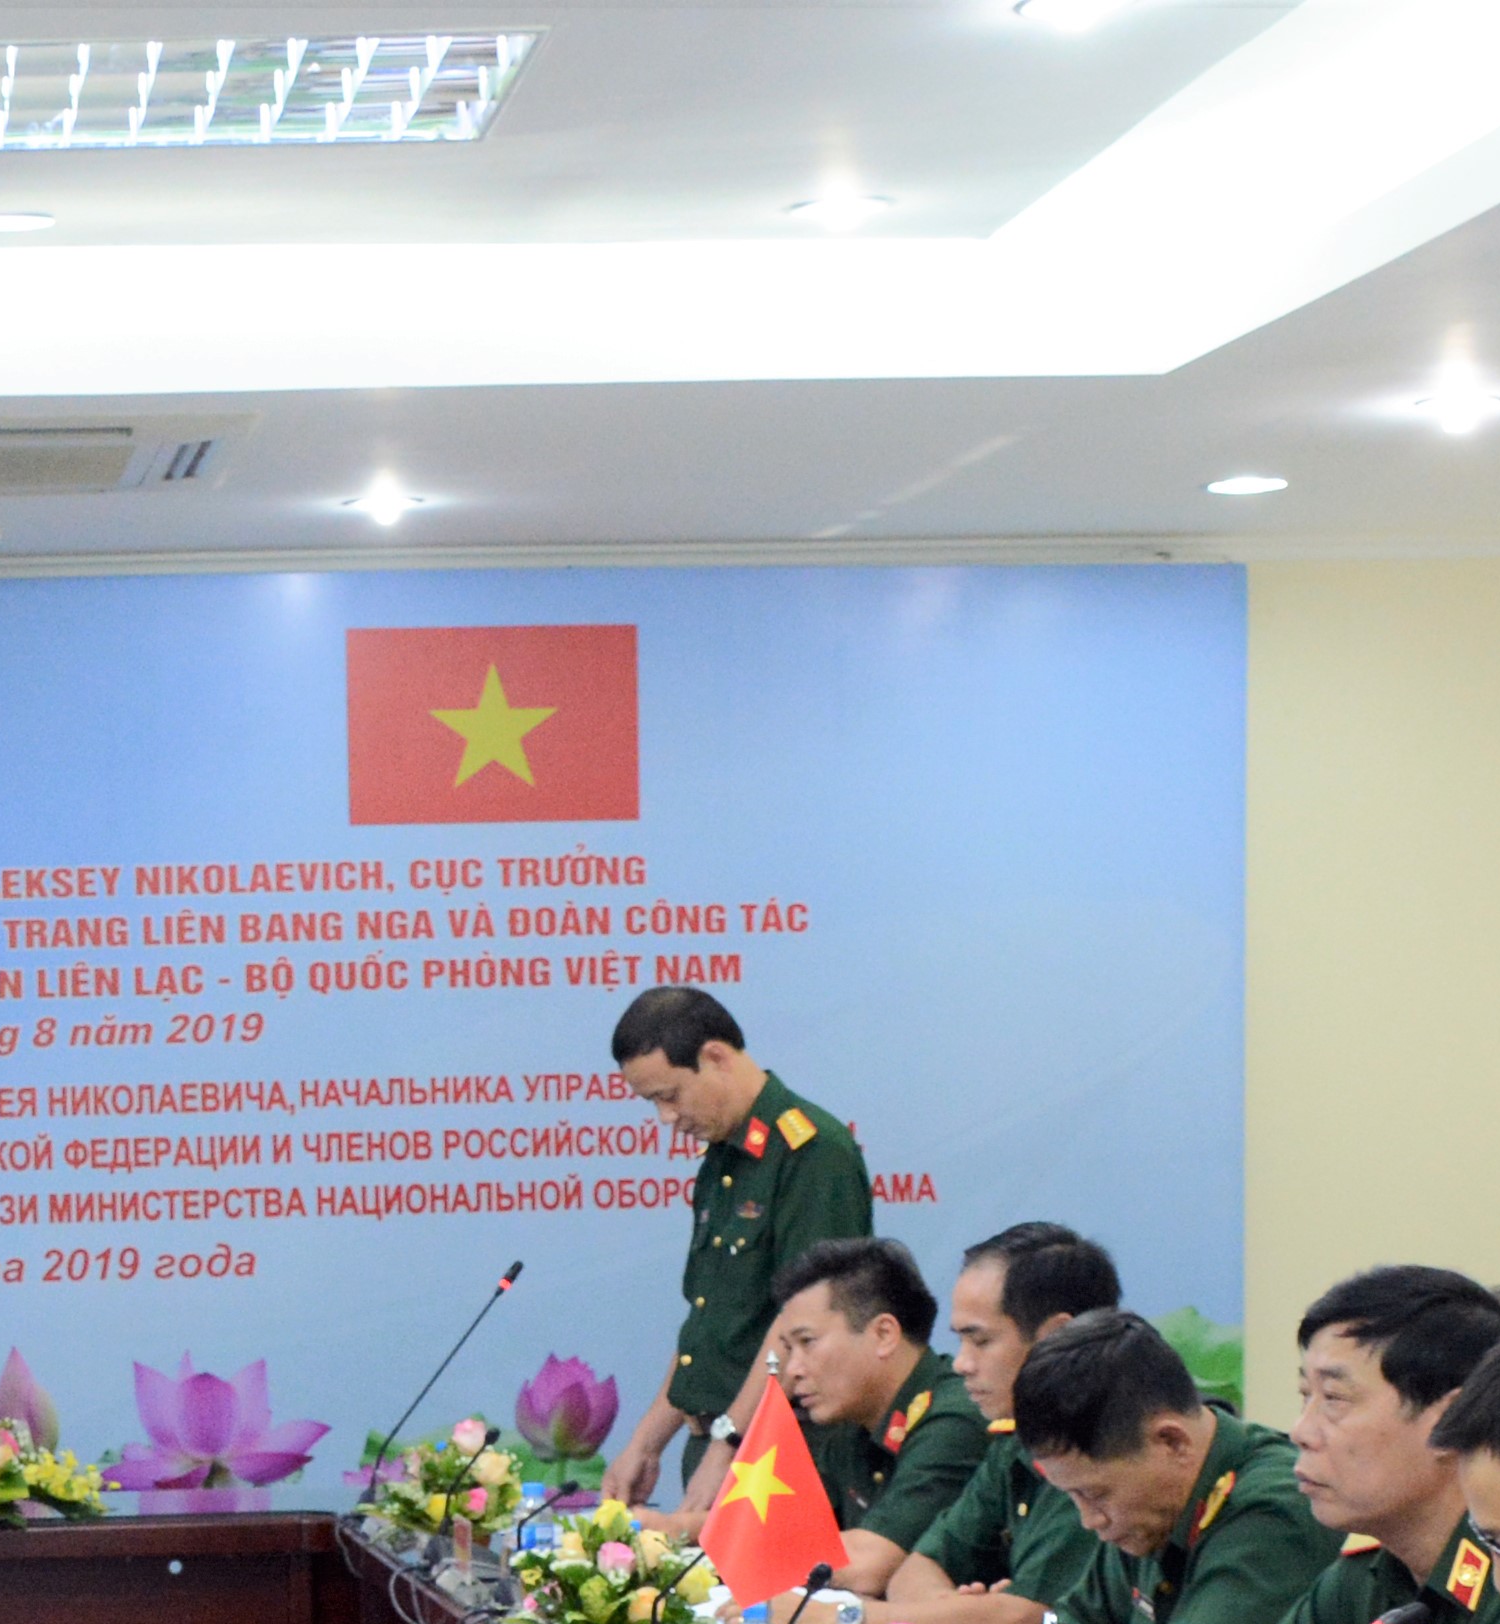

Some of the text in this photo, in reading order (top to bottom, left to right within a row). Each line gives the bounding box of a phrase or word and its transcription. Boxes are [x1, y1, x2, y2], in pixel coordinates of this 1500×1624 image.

[135, 861, 395, 896] NIKOLAEVICH,
[409, 858, 483, 895] CỤC
[497, 844, 646, 888] TRƯỞNG
[4, 917, 129, 949] TRANG
[143, 910, 226, 946] LIÊN
[239, 911, 343, 944] BANG
[357, 909, 435, 940] NGA
[448, 904, 495, 939] VÀ
[508, 902, 611, 938] ĐOÀN
[625, 899, 727, 935] CÔNG
[740, 898, 808, 933] TÁC
[37, 962, 120, 998] LIÊN
[134, 964, 204, 1002] LẠC
[245, 957, 295, 999] BỘ
[309, 952, 408, 995] QUỐC
[423, 952, 551, 989] PHÒNG
[564, 950, 642, 991] VIỆT
[655, 953, 742, 986] NAM
[33, 1017, 56, 1048] 8
[70, 1016, 153, 1046] năm
[167, 1012, 264, 1044] 2019
[523, 1073, 638, 1103] УПРАВ
[64, 1136, 262, 1173] ФЕДЕРАЦИИ
[272, 1135, 293, 1164] И
[303, 1130, 433, 1163] ЧЛЕНОВ
[443, 1119, 660, 1160] РОССИЙСКОЙ
[49, 1187, 307, 1223] МИНИСТЕРСТВА
[316, 1174, 583, 1220] НАЦИОНАЛЬНОЙ
[592, 1176, 697, 1210] ОБОРО
[43, 1246, 140, 1282] 2019
[154, 1243, 257, 1280] года
